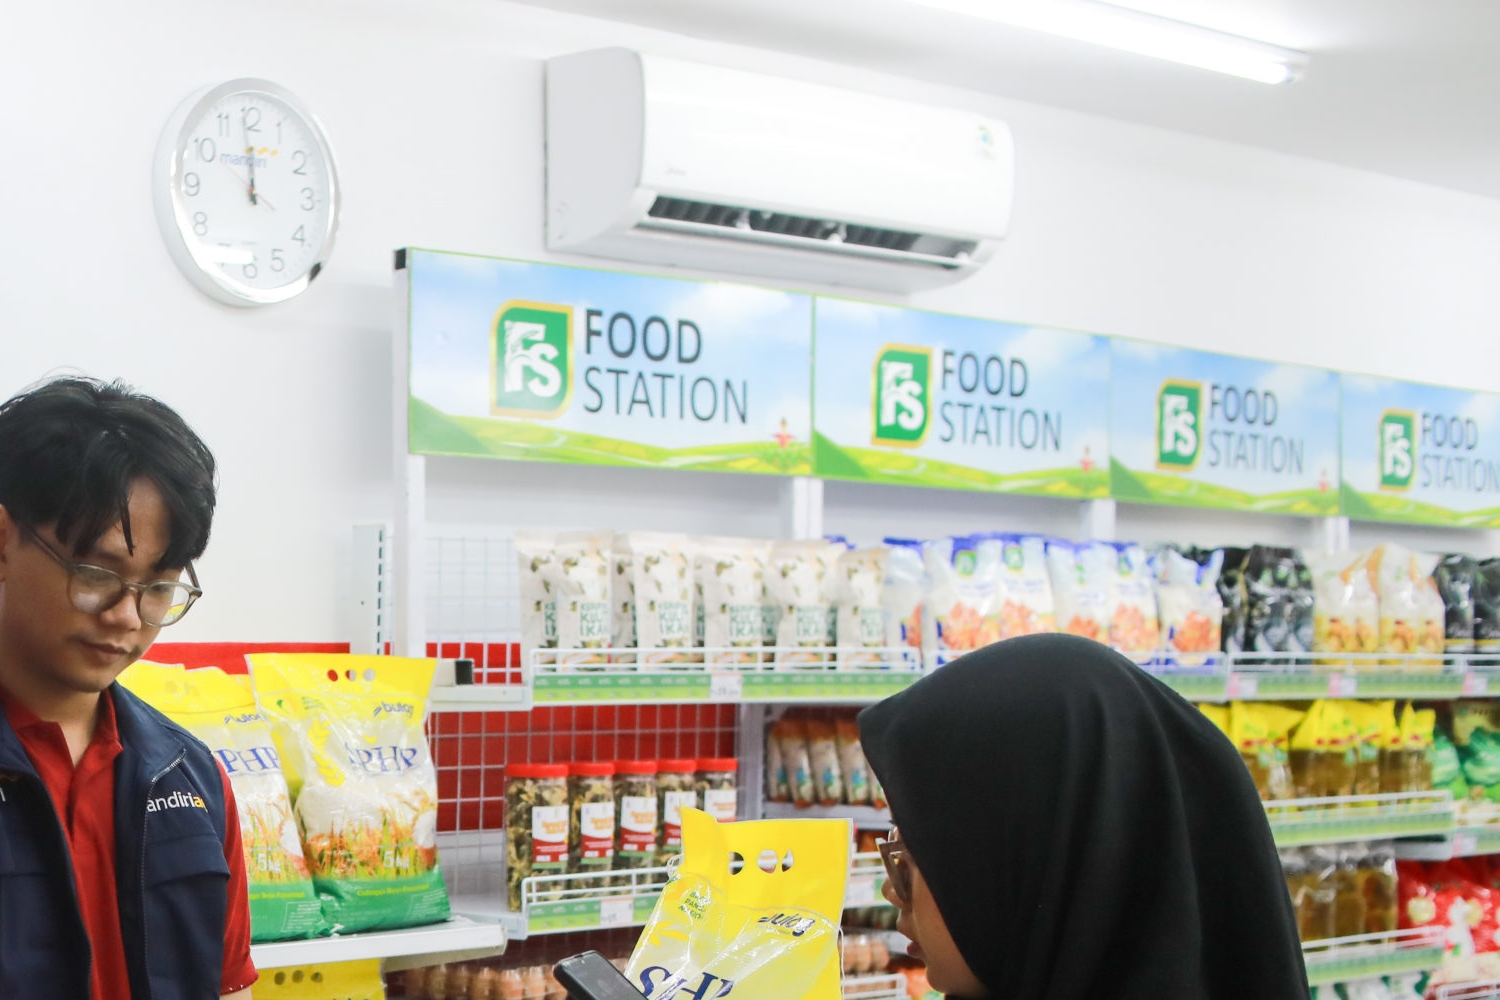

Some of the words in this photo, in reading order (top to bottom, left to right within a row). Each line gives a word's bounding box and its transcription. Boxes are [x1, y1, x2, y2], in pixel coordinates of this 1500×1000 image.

[195, 137, 217, 163] 10
[292, 149, 307, 176] 2
[184, 171, 201, 197] 9
[300, 187, 315, 212] 3
[193, 210, 208, 237] 8
[291, 224, 306, 248] 4
[270, 248, 285, 273] 5
[584, 308, 702, 365] FOOD
[940, 349, 1029, 398] FOOD
[583, 365, 749, 425] STATION
[1208, 382, 1279, 427] FOOD
[938, 400, 1062, 452] STATION
[1420, 412, 1479, 451] FOOD
[1207, 428, 1304, 475] STATION
[214, 746, 279, 774] PHP
[345, 742, 418, 773] PHP
